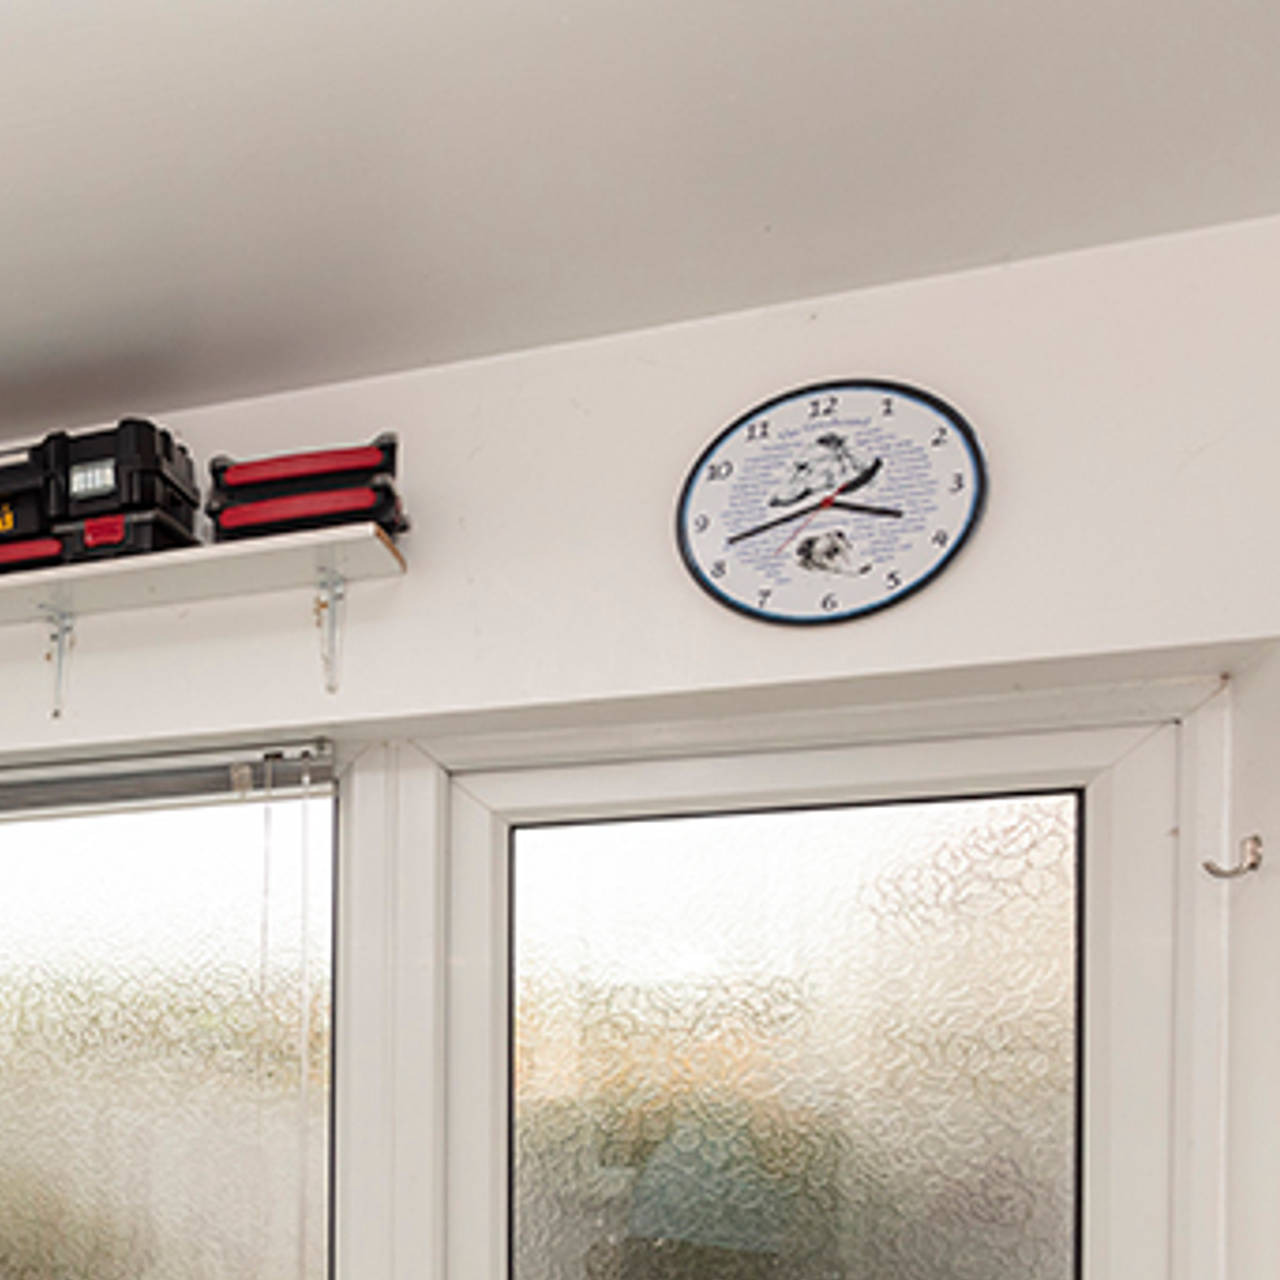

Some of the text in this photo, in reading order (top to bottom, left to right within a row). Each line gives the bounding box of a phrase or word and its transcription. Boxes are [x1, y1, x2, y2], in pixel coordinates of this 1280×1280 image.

[808, 396, 838, 418] 12
[882, 398, 894, 416] 1
[746, 420, 769, 441] 11
[931, 427, 948, 446] 2
[706, 460, 734, 482] 10
[948, 473, 964, 494] 3
[694, 513, 710, 534] 9
[931, 530, 948, 547] 4
[710, 561, 726, 579] 8
[886, 571, 902, 590] 5
[758, 588, 772, 608] 7
[821, 592, 838, 612] 6
